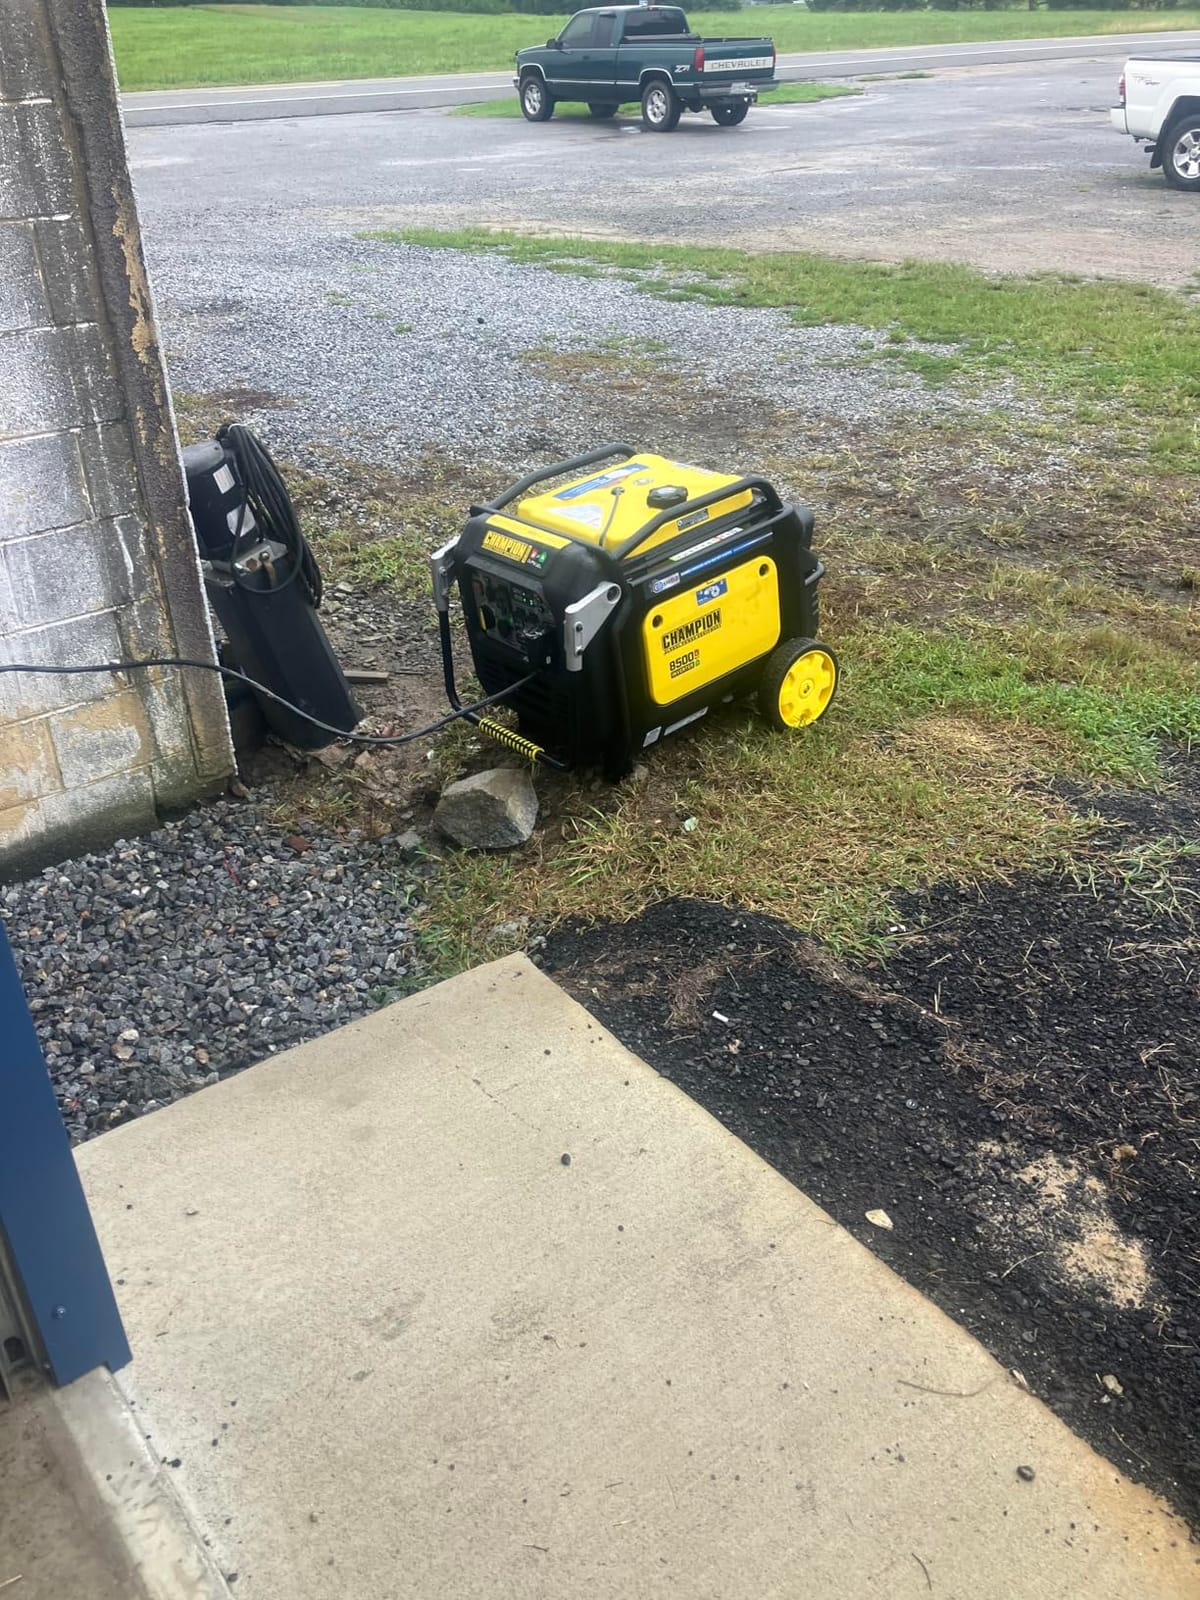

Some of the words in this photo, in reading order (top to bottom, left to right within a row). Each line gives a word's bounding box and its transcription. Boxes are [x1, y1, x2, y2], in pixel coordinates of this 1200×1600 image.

[674, 64, 691, 73] Z71
[711, 58, 767, 70] CHEVROLET
[483, 530, 529, 559] CHAMPION
[661, 608, 721, 650] CHAMPION
[669, 651, 695, 672] 8500
